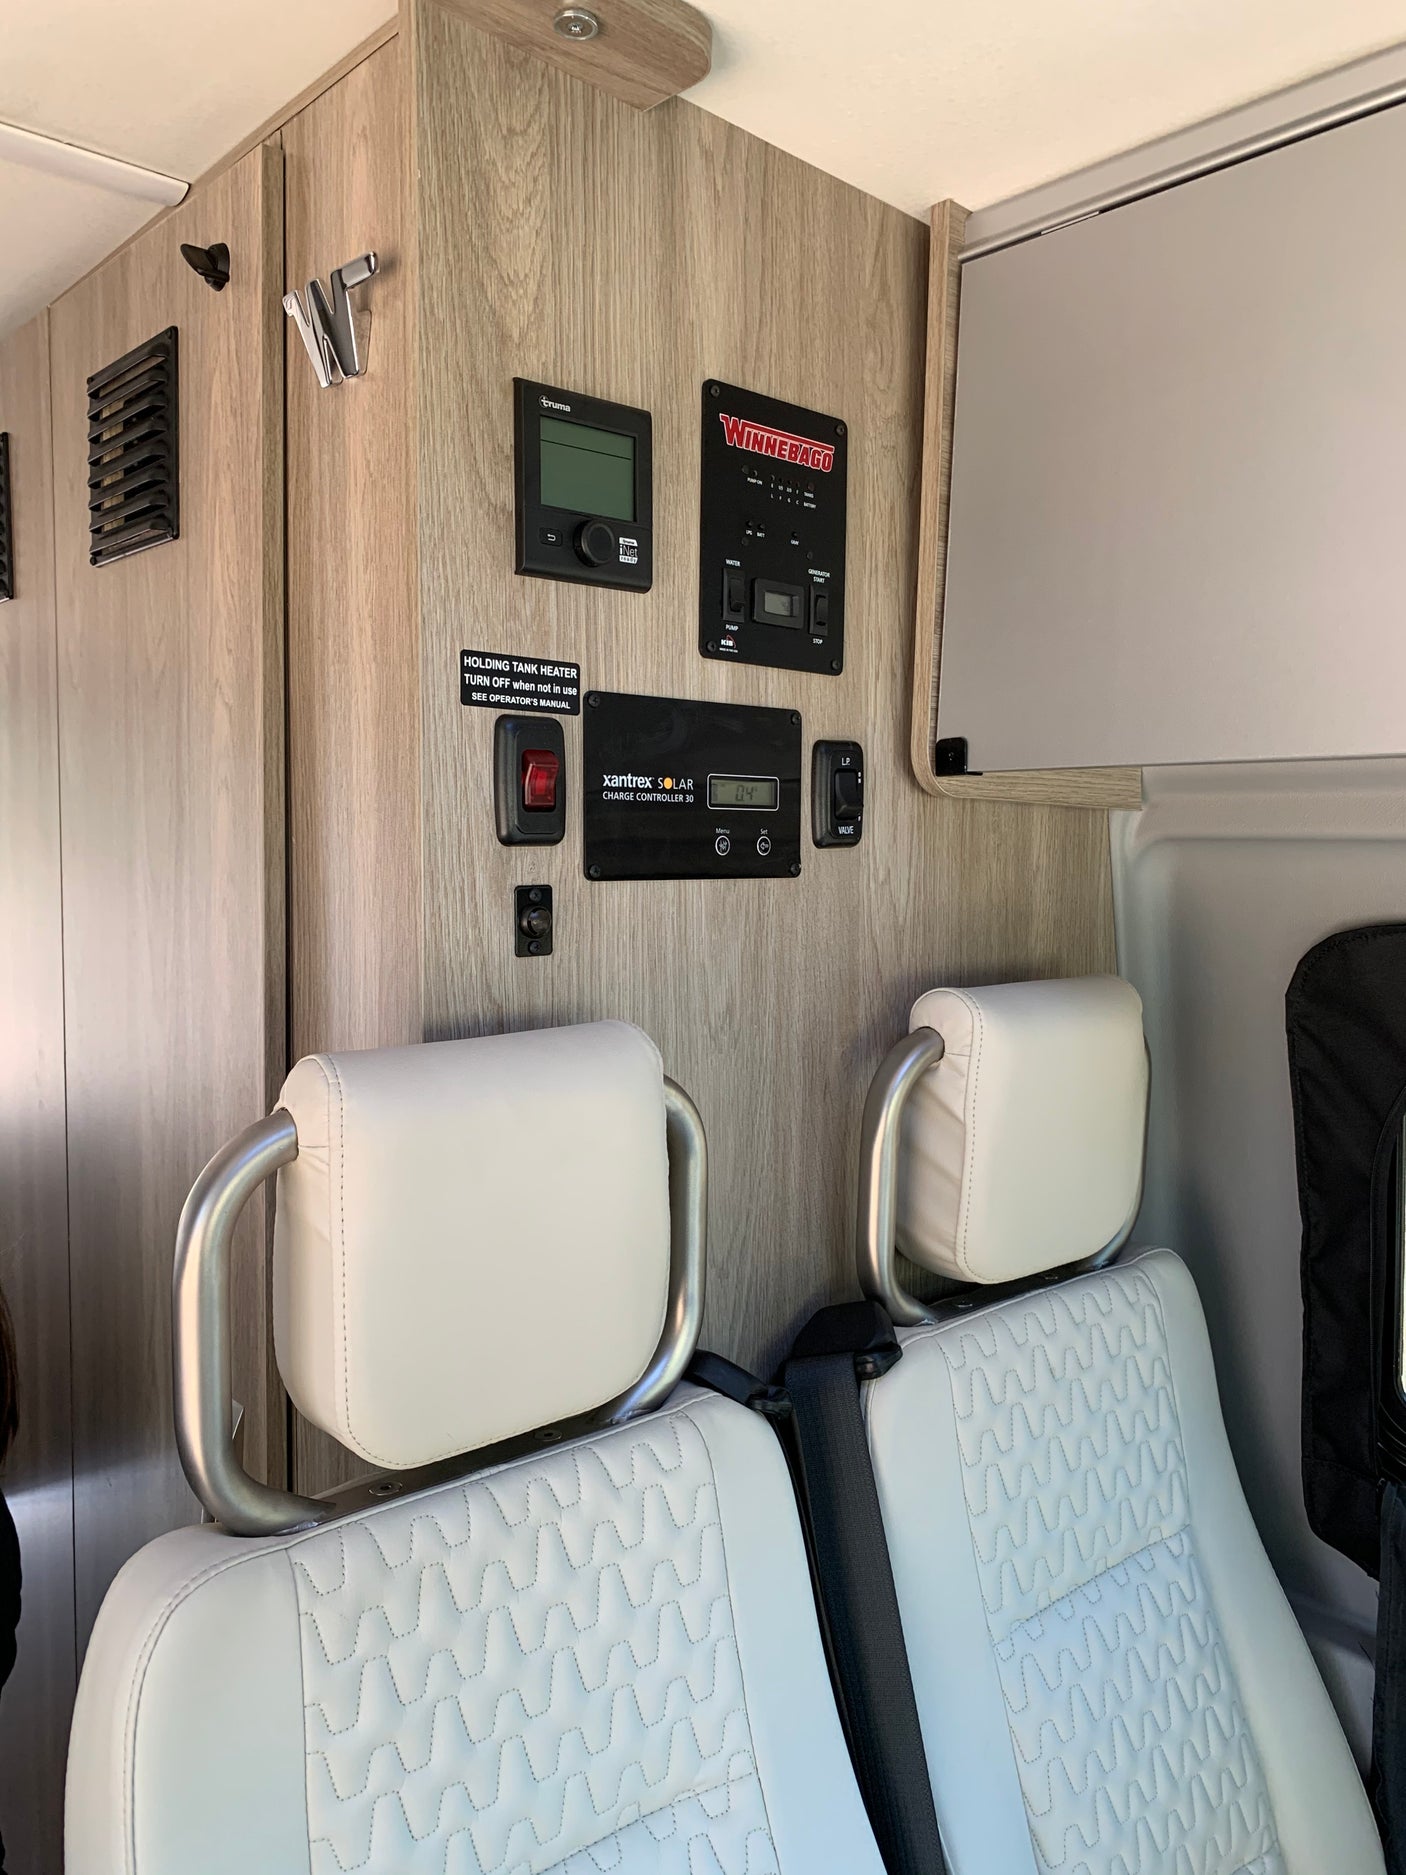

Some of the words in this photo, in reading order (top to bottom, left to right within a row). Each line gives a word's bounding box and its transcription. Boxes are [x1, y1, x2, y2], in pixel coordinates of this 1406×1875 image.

[540, 395, 571, 412] truma
[719, 413, 835, 472] WINNEBAGO
[725, 559, 741, 567] WATER
[808, 568, 830, 578] GENERATOR
[464, 656, 509, 671] HOLDING
[512, 661, 538, 675] TANK
[540, 664, 578, 679] HEATER
[463, 673, 490, 687] TURN
[492, 676, 511, 689] OFF
[512, 680, 536, 692] when
[537, 683, 552, 693] not
[552, 683, 561, 694] in
[562, 686, 578, 696] use
[471, 692, 488, 702] SEE
[489, 694, 538, 706] OPERATOR'S
[539, 699, 571, 710] MANUAL
[602, 772, 653, 789] xantrex
[657, 777, 694, 791] SOLAR
[602, 791, 635, 801] CHARGE
[636, 792, 684, 803] CONTROLLER
[685, 794, 694, 803] 30
[715, 827, 731, 835] Menu
[760, 828, 769, 836] Set
[838, 826, 855, 835] VALVE
